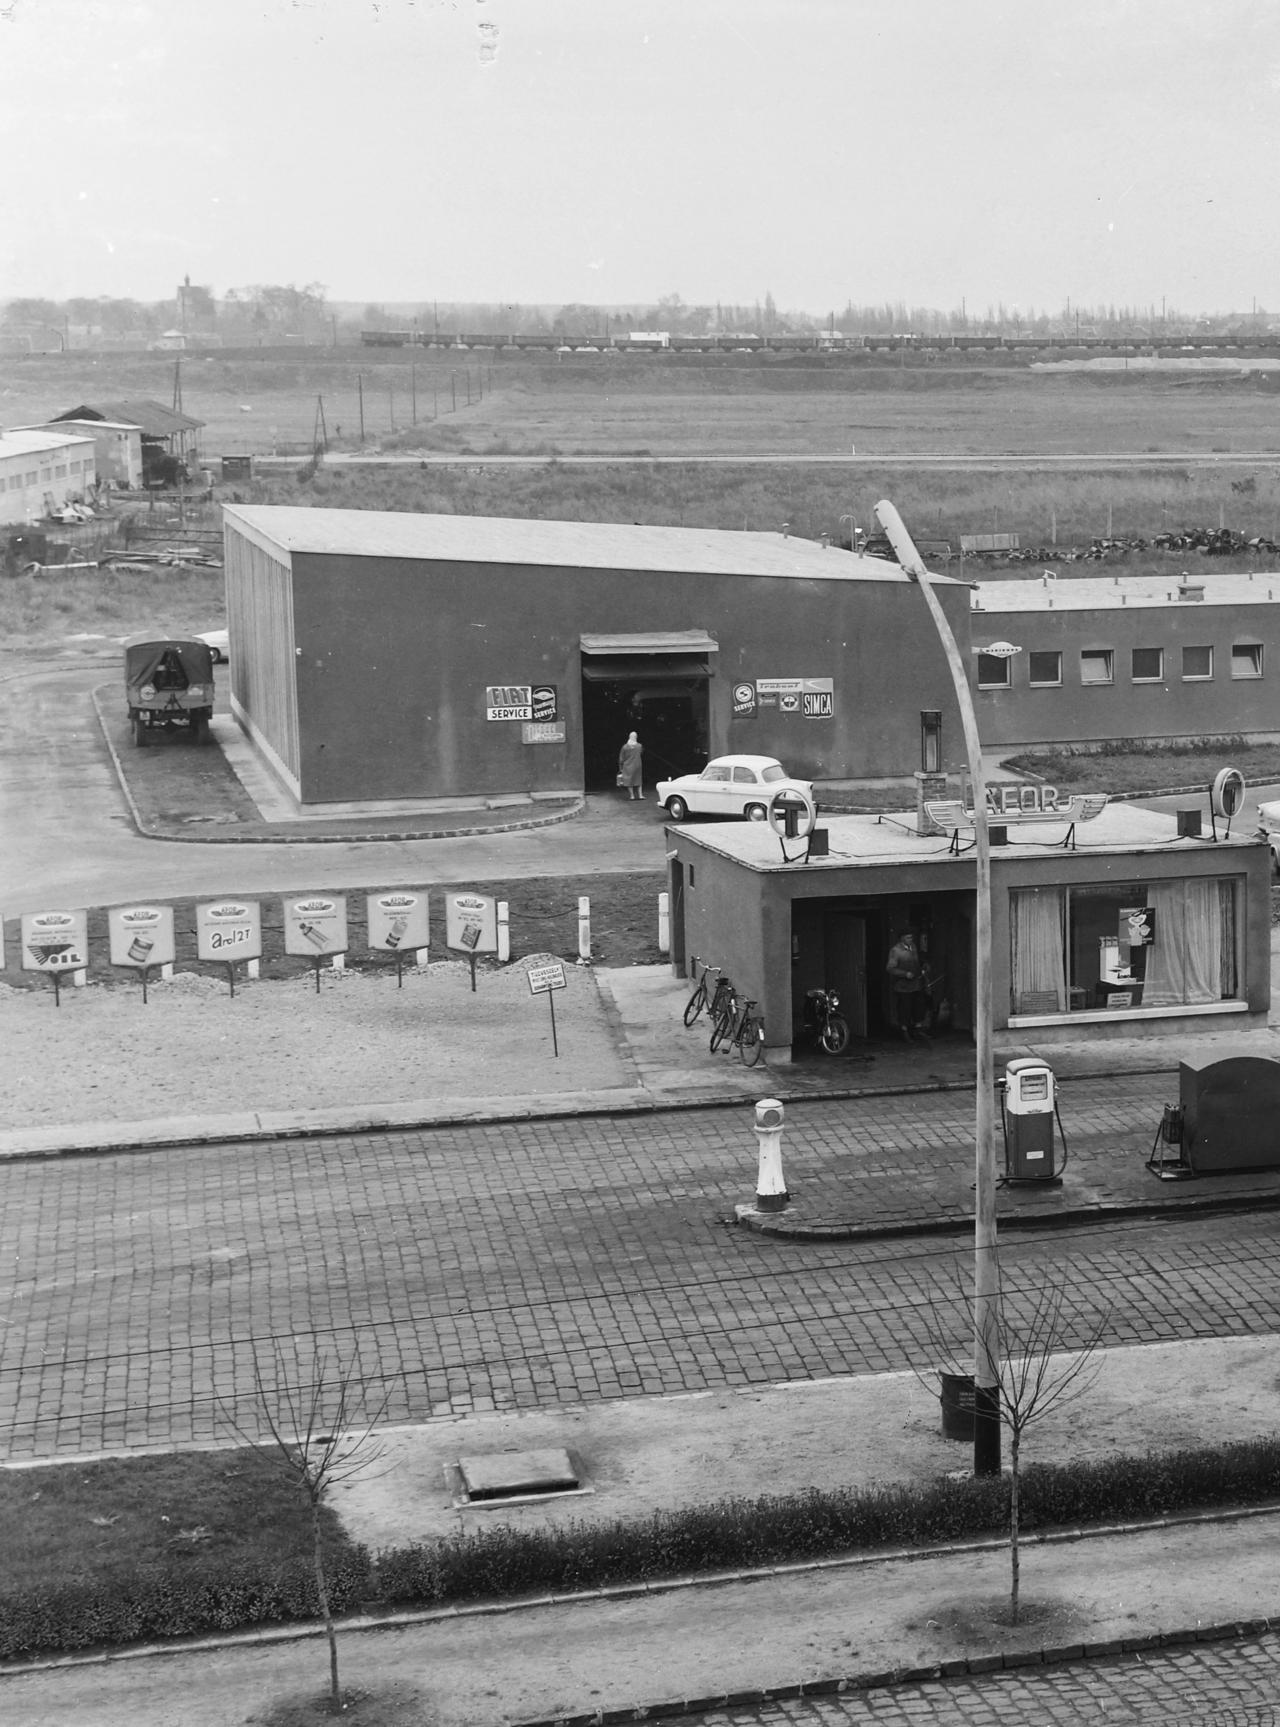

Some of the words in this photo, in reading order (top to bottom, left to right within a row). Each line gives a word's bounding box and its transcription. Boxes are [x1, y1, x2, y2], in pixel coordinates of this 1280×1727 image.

[491, 687, 529, 706] FIAT
[734, 701, 756, 712] SERVICE
[804, 693, 832, 715] SIMCA
[491, 708, 529, 719] SERVICE
[533, 707, 556, 719] SERVICE
[49, 953, 81, 964] OIL
